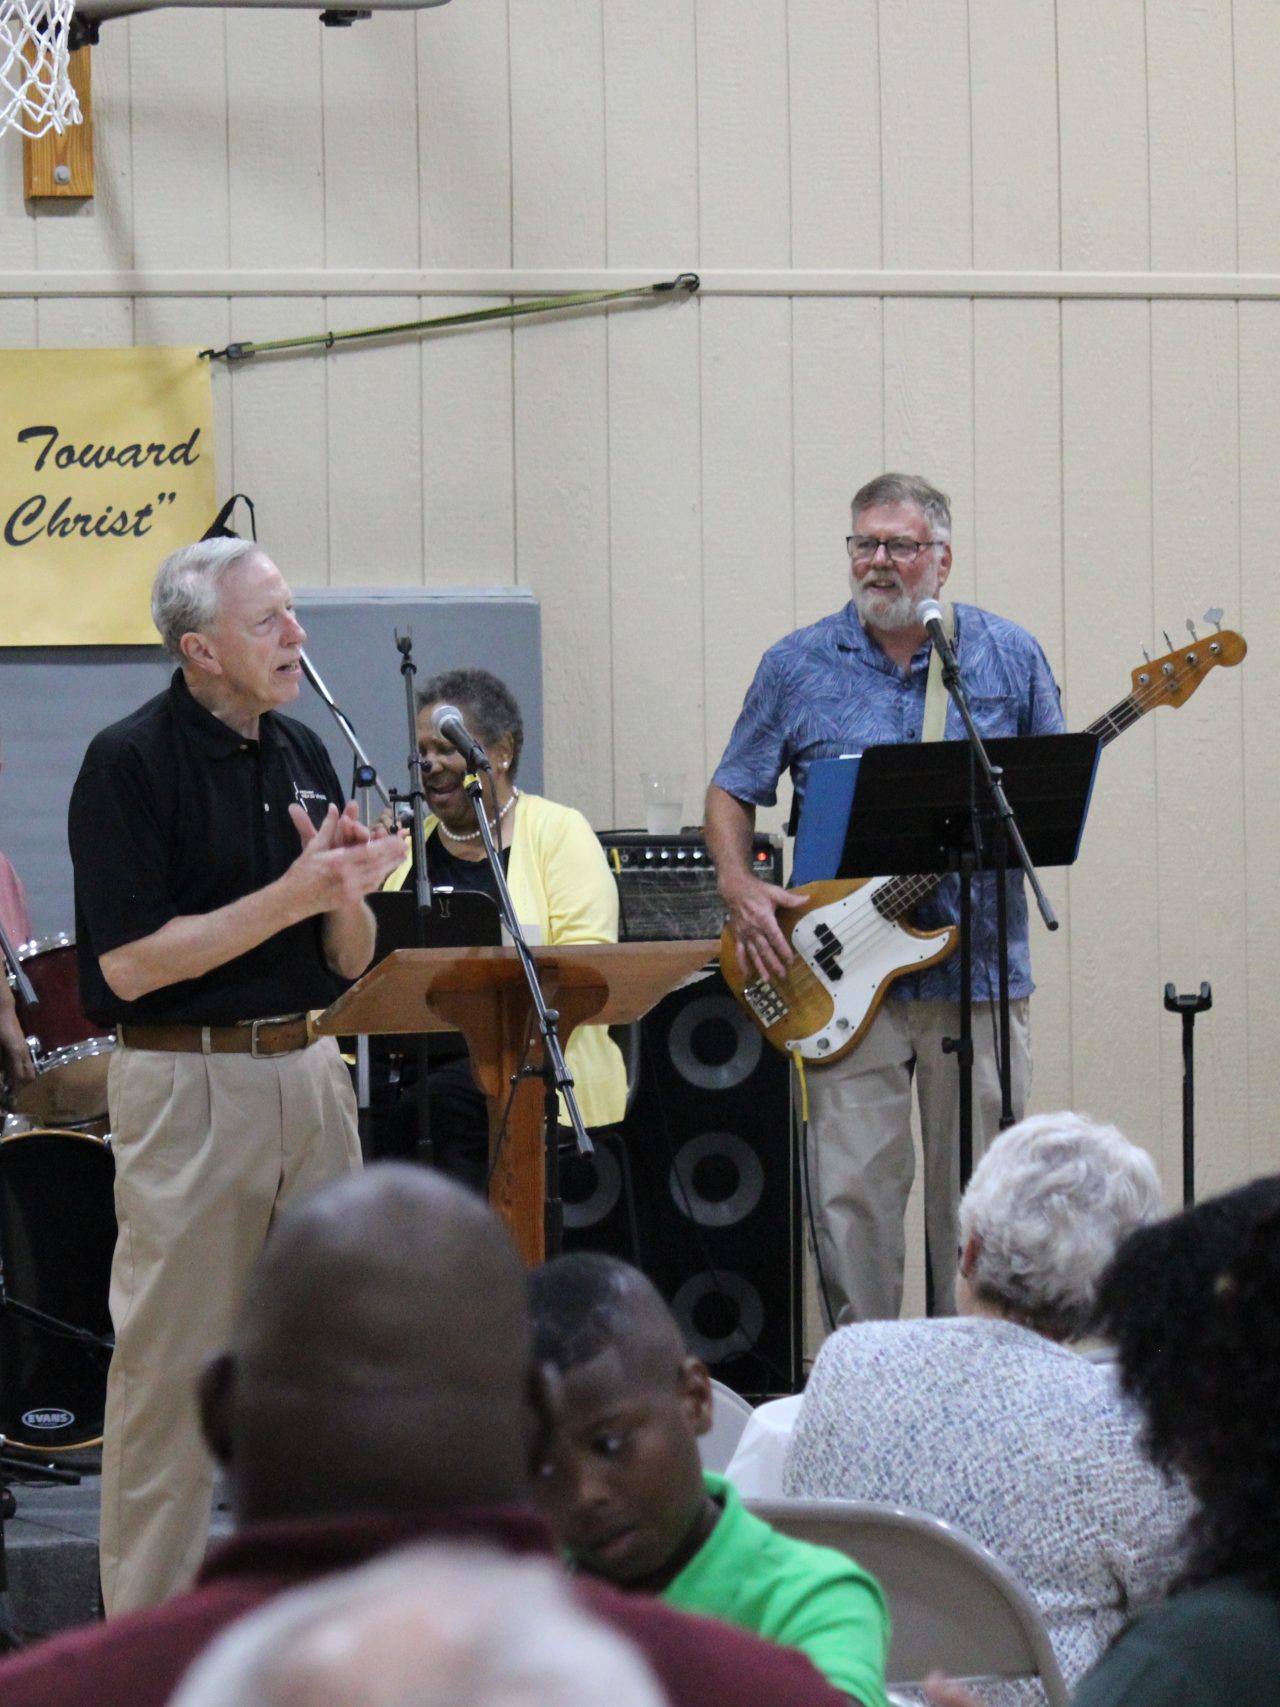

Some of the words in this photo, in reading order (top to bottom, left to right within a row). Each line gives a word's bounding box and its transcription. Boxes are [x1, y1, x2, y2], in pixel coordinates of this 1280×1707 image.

[18, 425, 200, 471] Toward
[4, 492, 176, 546] Christ”
[27, 1413, 68, 1423] EVANS
